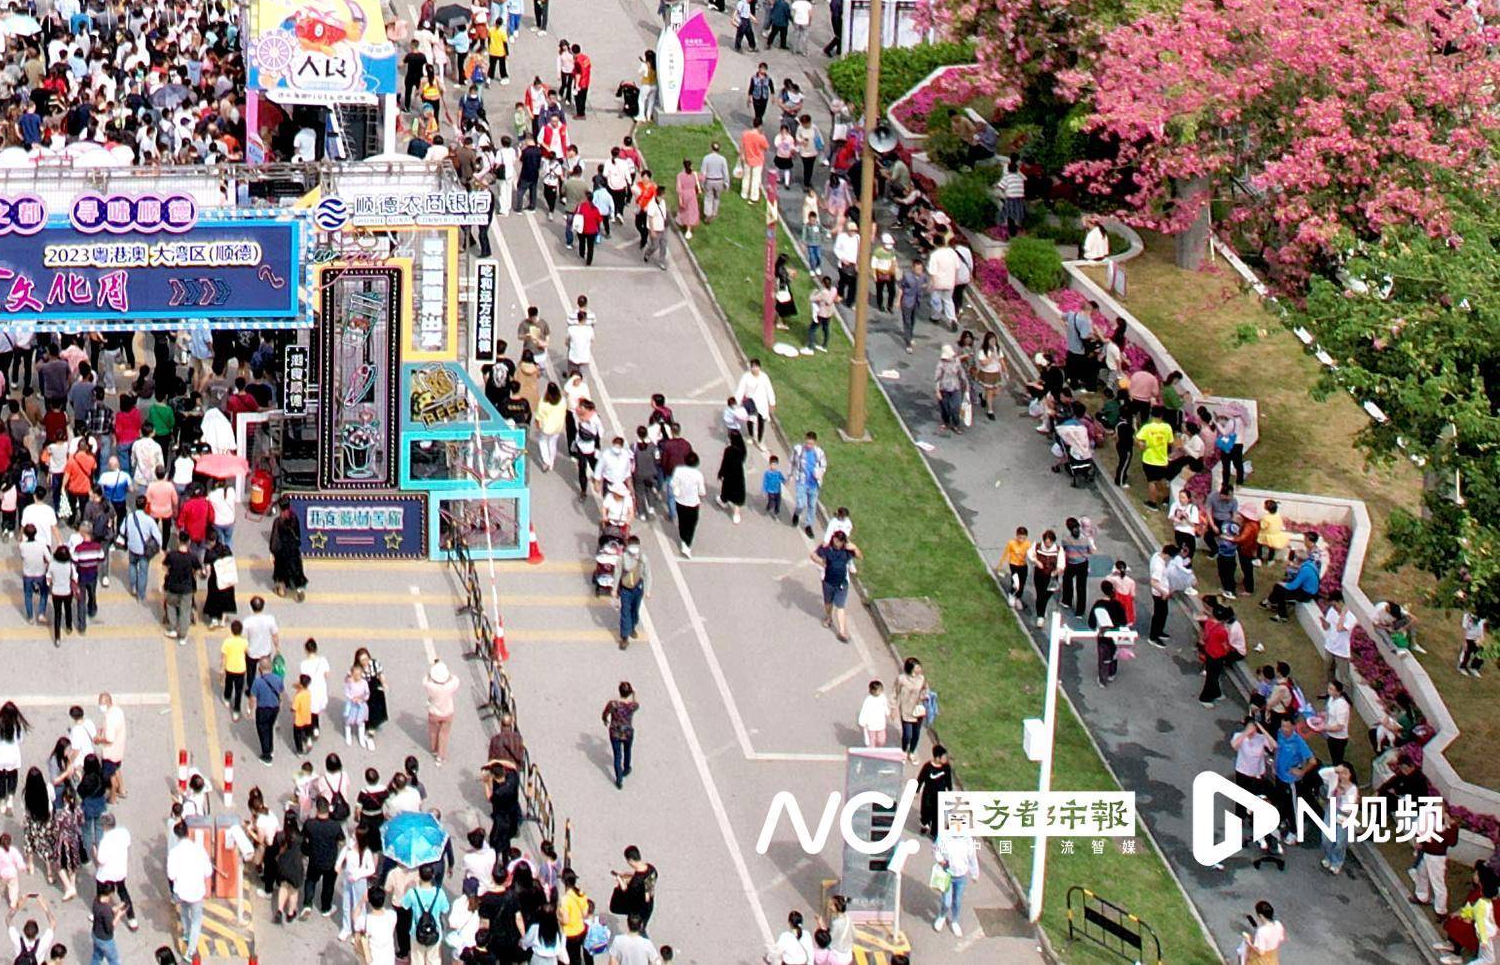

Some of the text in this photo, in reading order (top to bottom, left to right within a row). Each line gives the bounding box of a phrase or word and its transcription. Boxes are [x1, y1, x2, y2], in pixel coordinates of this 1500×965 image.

[74, 200, 195, 225] 寻味顺德
[355, 192, 491, 215] 顺德农商银行
[422, 397, 467, 426] BEER
